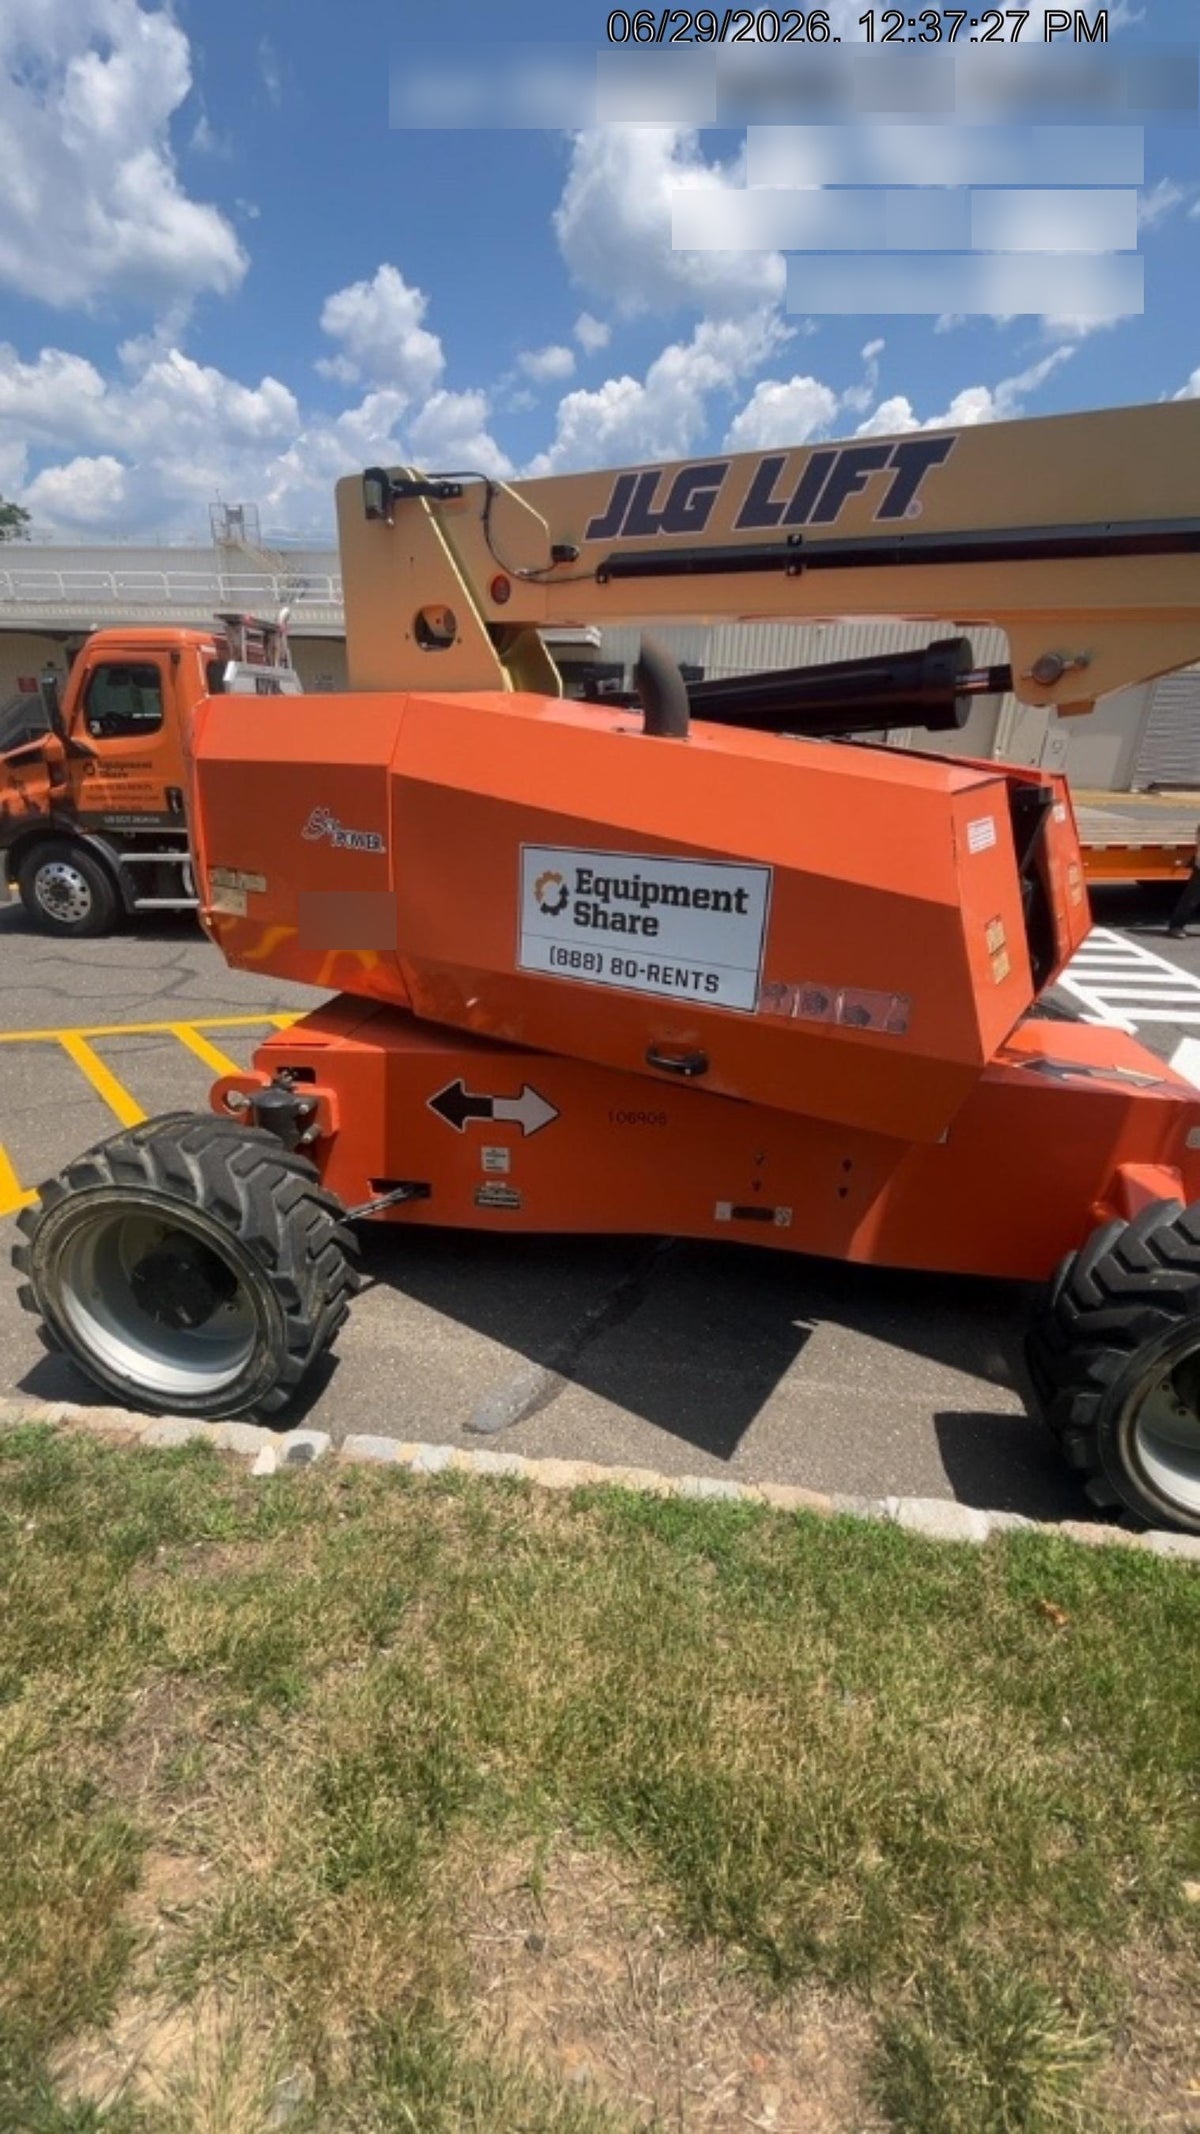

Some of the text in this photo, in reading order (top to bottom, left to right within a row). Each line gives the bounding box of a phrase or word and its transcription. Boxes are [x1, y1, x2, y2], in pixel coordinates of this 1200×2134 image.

[584, 434, 960, 542] JLG LIFT
[574, 867, 749, 915] Equipment
[573, 901, 660, 937] Share
[549, 946, 720, 994] (888) 80-RENTS
